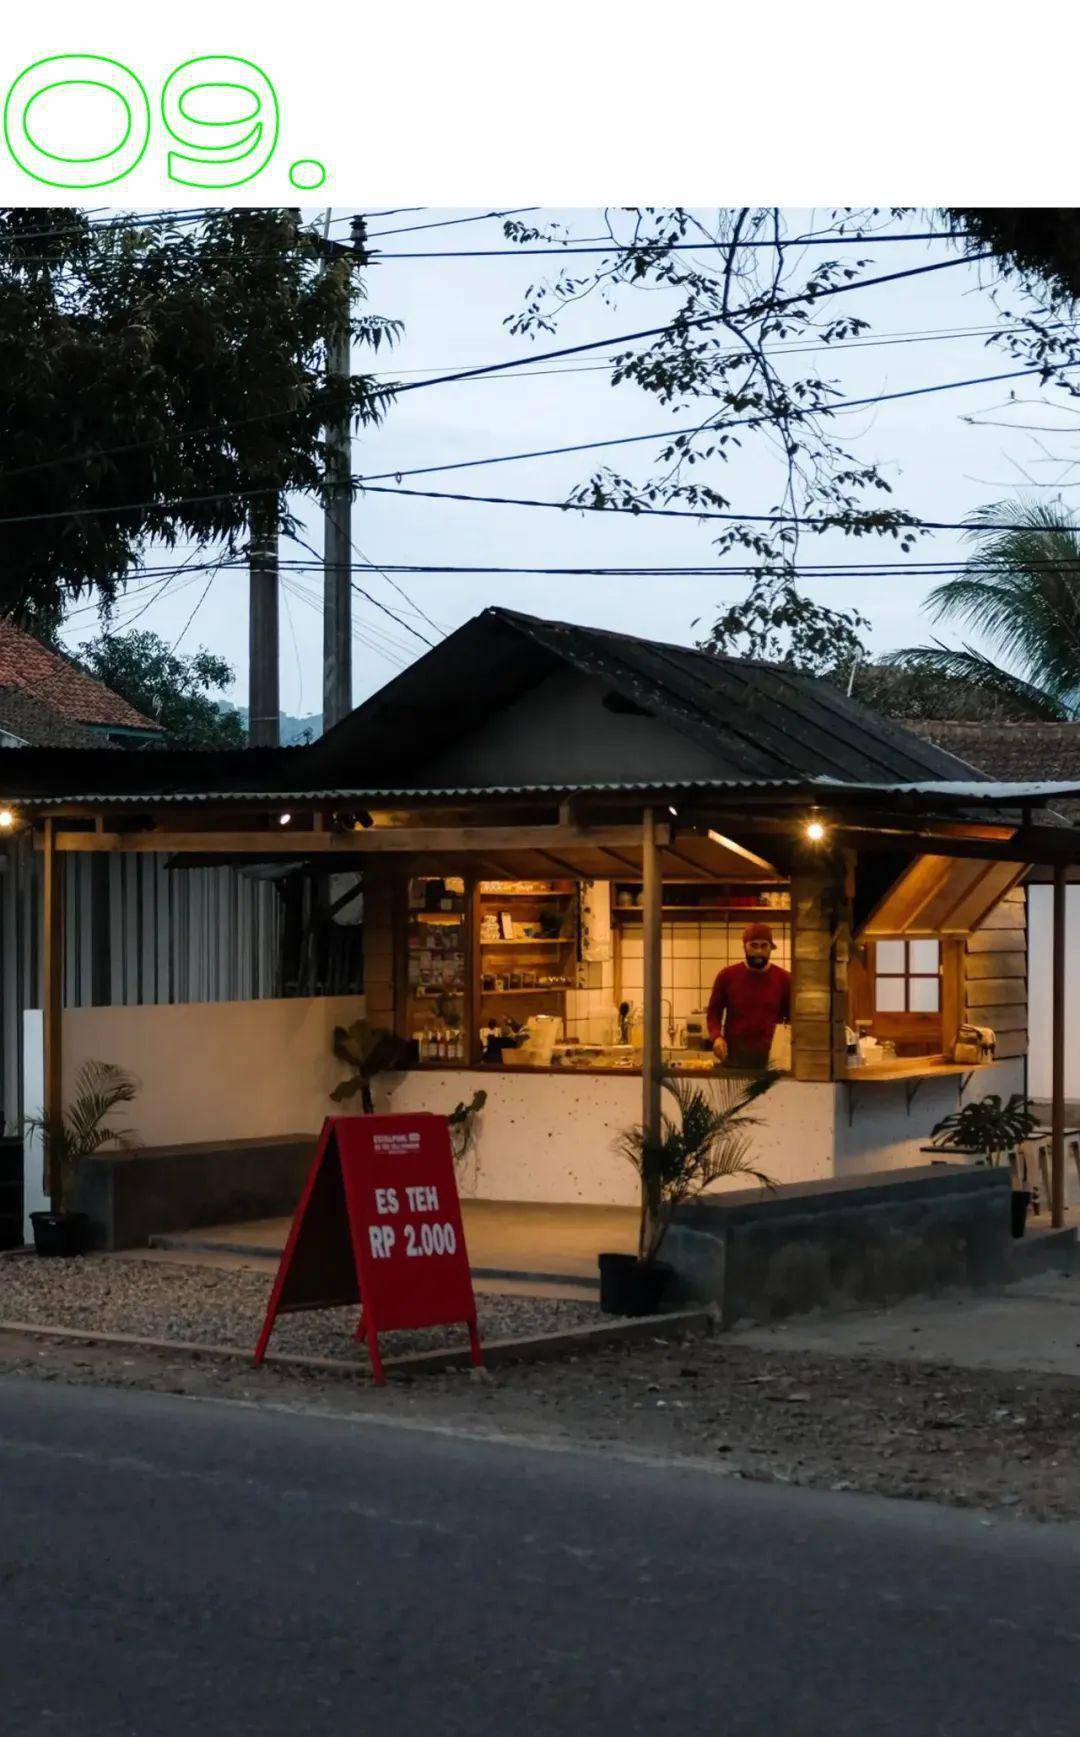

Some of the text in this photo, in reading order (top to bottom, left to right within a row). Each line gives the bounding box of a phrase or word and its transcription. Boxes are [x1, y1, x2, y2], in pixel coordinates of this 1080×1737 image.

[375, 1186, 439, 1214] ES TEH
[368, 1222, 456, 1259] RP 2.000
